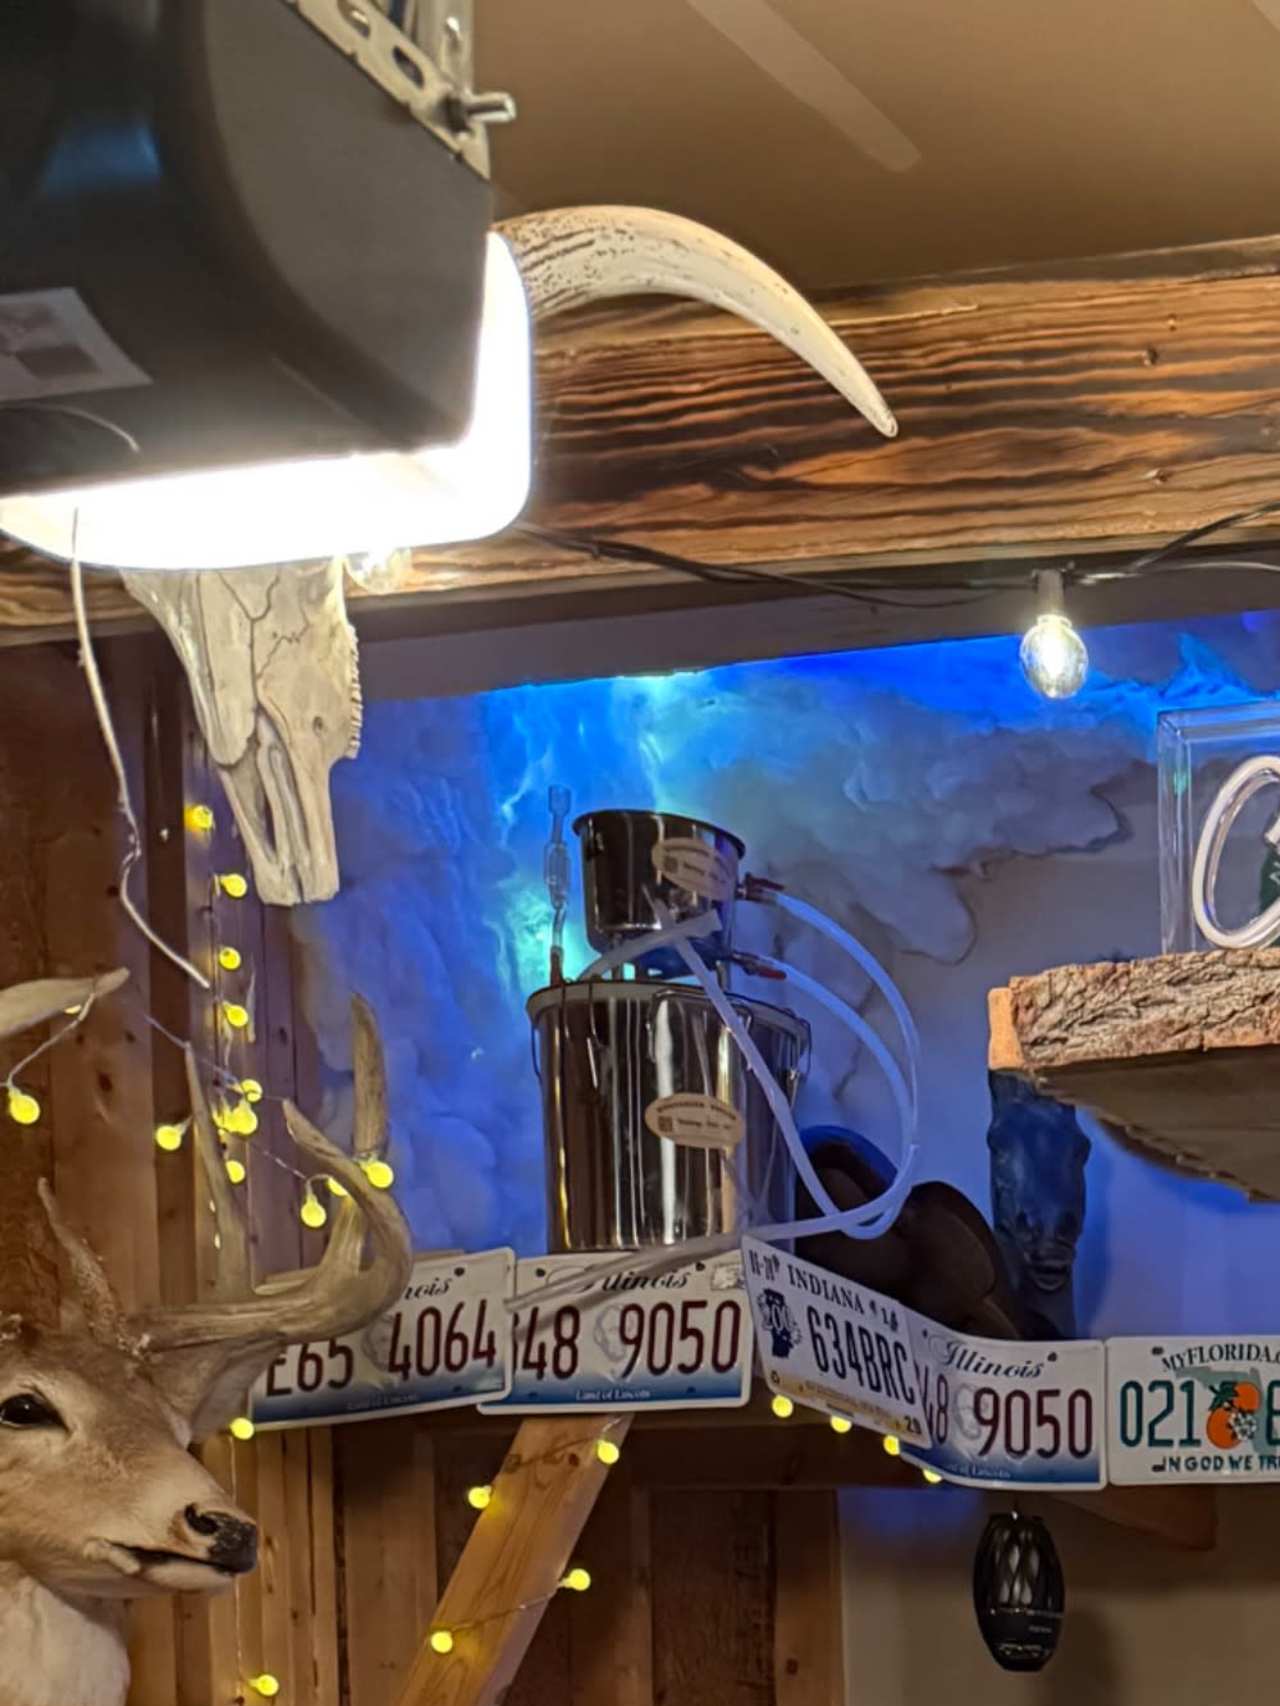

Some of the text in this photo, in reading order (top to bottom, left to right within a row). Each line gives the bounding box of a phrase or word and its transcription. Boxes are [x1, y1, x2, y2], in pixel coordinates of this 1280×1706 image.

[788, 1264, 865, 1316] INDIANA
[388, 1299, 496, 1381] 4064
[618, 1299, 742, 1379] 9050
[806, 1304, 917, 1406] 634BRC
[938, 1338, 1044, 1380] Illinois
[973, 1386, 1094, 1460] 9050
[1119, 1379, 1201, 1448] 021
[1163, 1456, 1181, 1471] IN
[1184, 1455, 1224, 1471] GOD
[1228, 1455, 1253, 1471] WE
